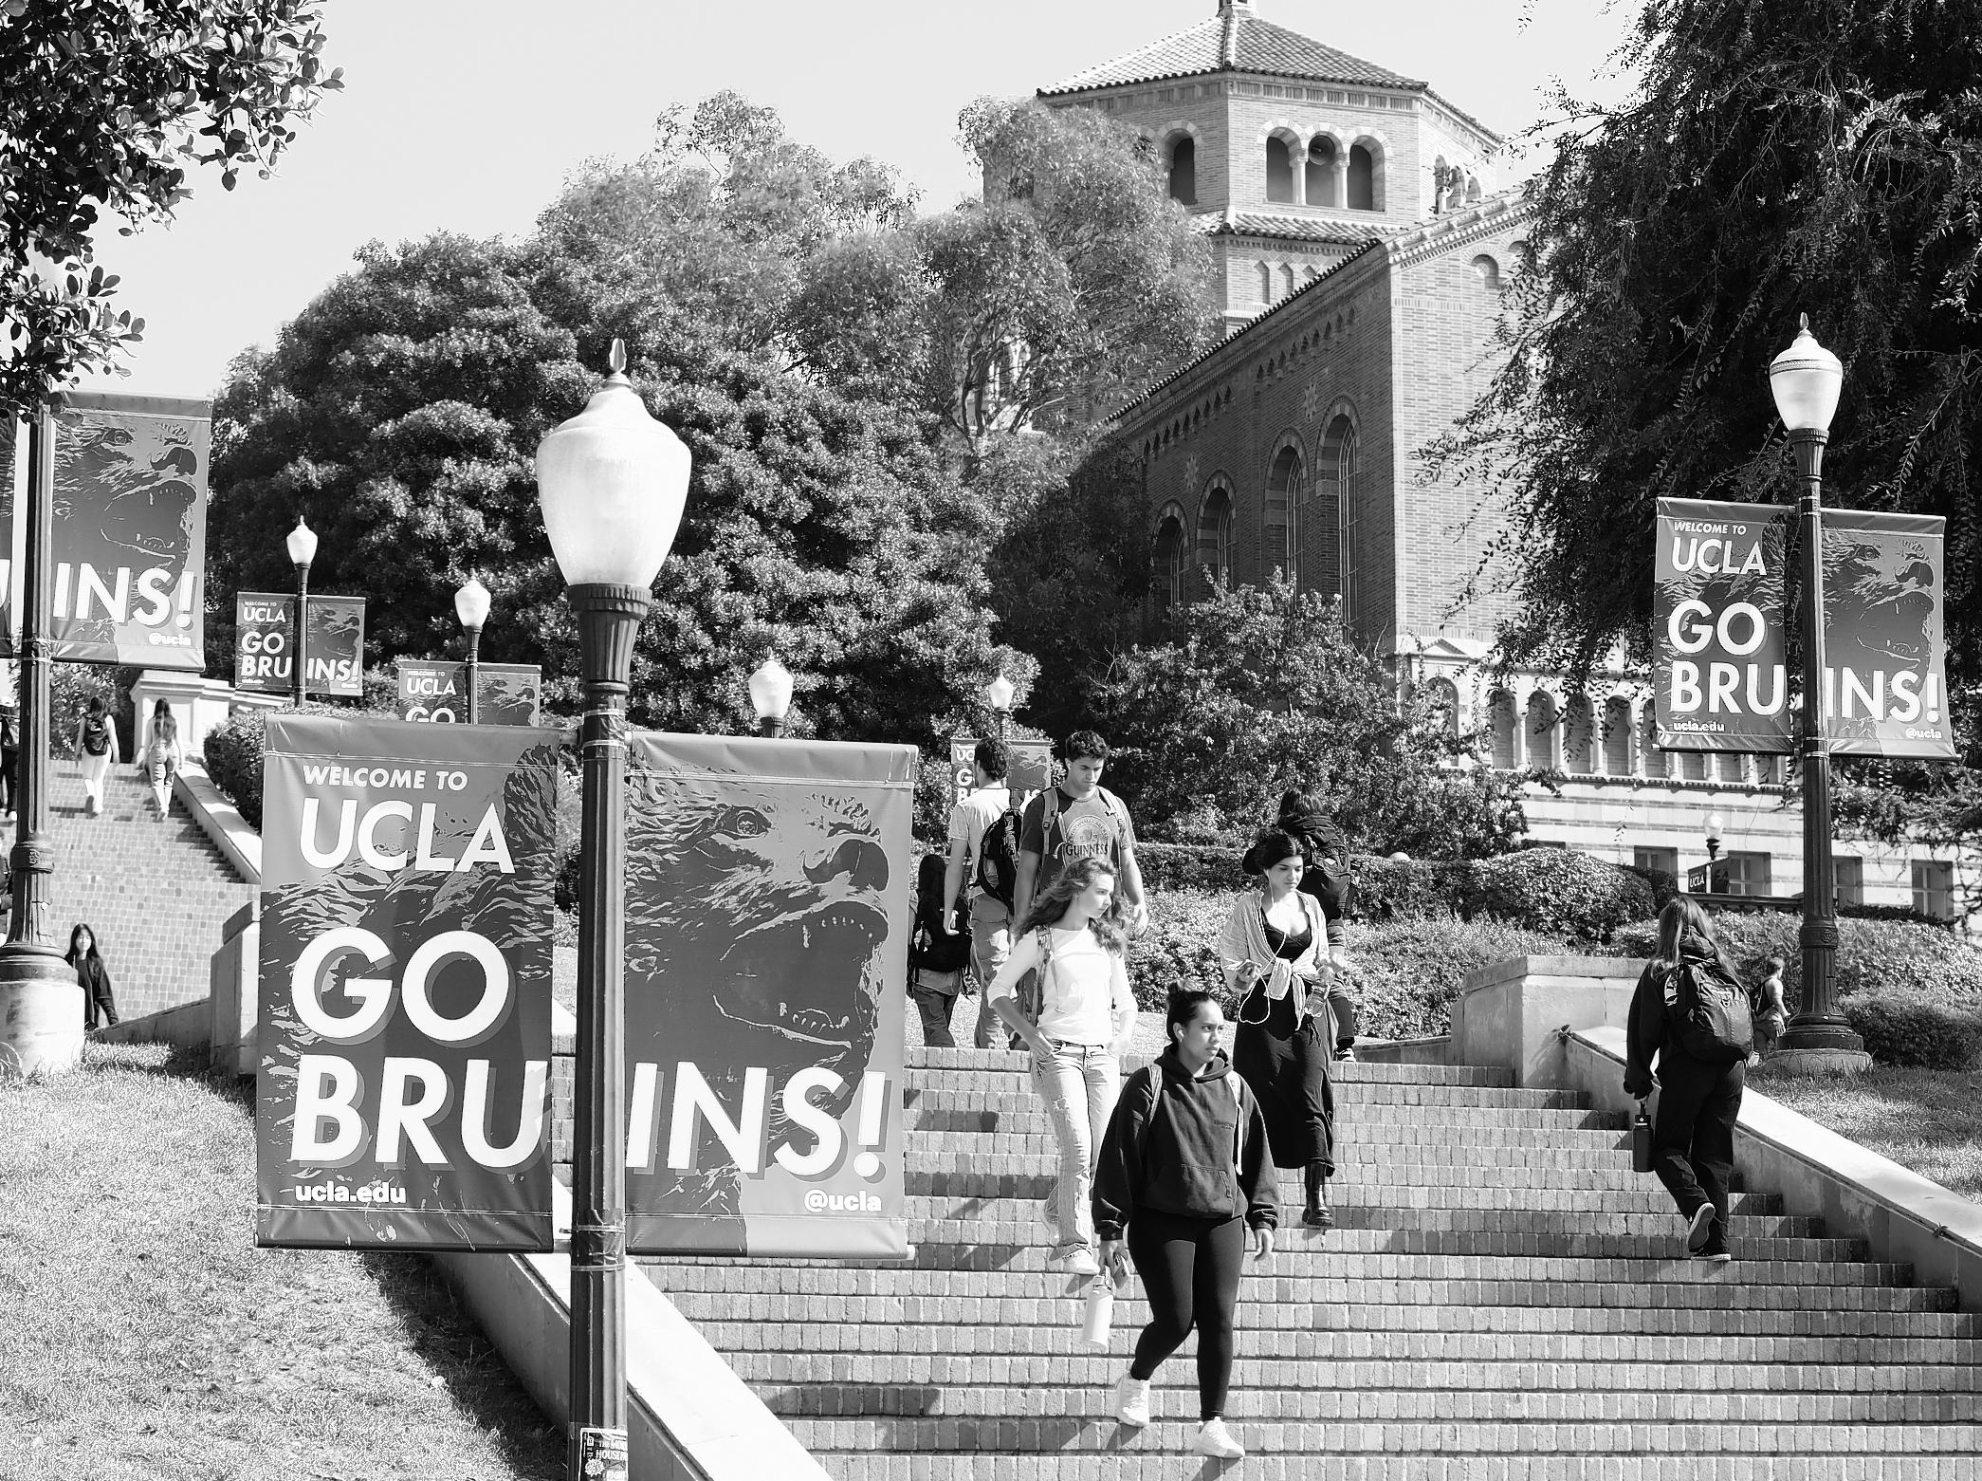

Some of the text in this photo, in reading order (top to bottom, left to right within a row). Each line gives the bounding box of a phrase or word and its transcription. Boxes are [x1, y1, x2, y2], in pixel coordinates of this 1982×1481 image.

[1674, 521, 1747, 536] WELCOME TO
[1672, 536, 1767, 576] UCLA
[52, 562, 195, 628] INS!
[243, 606, 286, 623] UCLA
[1668, 599, 1766, 656] GO
[241, 631, 285, 654] GO
[240, 655, 293, 678] BRU
[306, 657, 359, 682] INS!
[406, 678, 457, 695] UCLA
[1670, 660, 1785, 716] BRU
[1825, 666, 1940, 723] INS!
[405, 706, 456, 723] GO
[1673, 720, 1725, 732] ucla.edu
[1905, 727, 1942, 739] @ucla
[302, 765, 468, 792] WELCOME TO
[299, 797, 516, 874] UCLA
[291, 925, 511, 1042] GO
[290, 1053, 550, 1168] BRU
[626, 1060, 887, 1178] INS!
[294, 1182, 407, 1206] ucla.edu
[803, 1187, 882, 1213] @ucla
